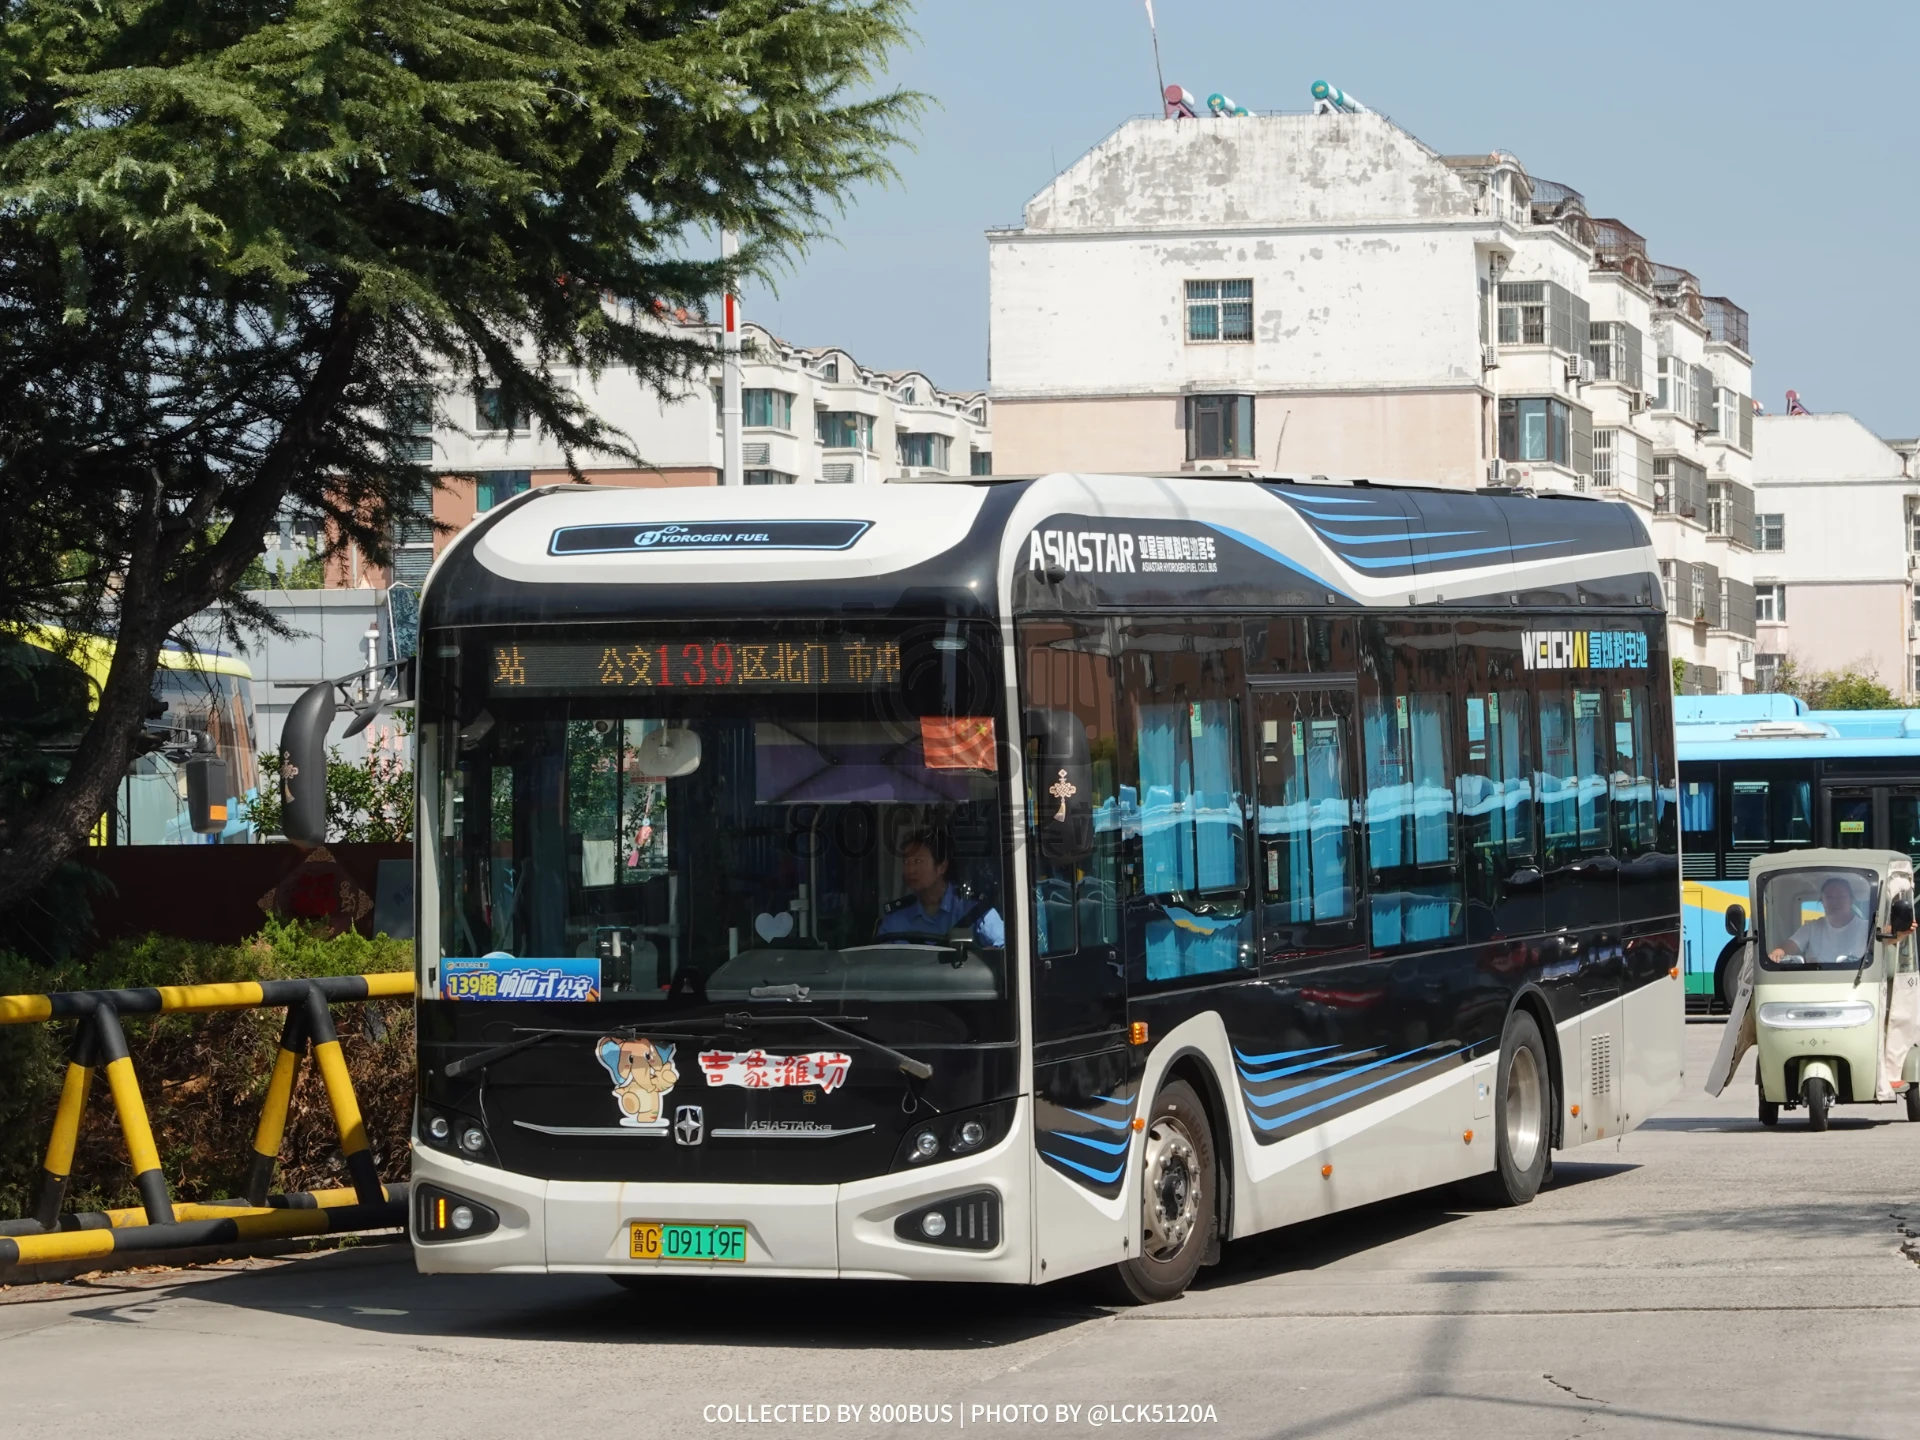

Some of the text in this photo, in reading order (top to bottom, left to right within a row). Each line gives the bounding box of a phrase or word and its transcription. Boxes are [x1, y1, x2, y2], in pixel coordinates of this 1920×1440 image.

[634, 530, 770, 546] HYDROGEN FUEL
[1029, 529, 1136, 573] ASIASTAR
[1138, 535, 1217, 561] 亚星氢燃料电池客车
[1164, 562, 1187, 573] HYDROGEN
[1209, 562, 1218, 573] BUS
[1521, 631, 1648, 670] WEICHAI 氢燃料电池
[493, 645, 526, 685] 站
[749, 1120, 815, 1131] ASIASTAR
[667, 1229, 743, 1256] 09119F
